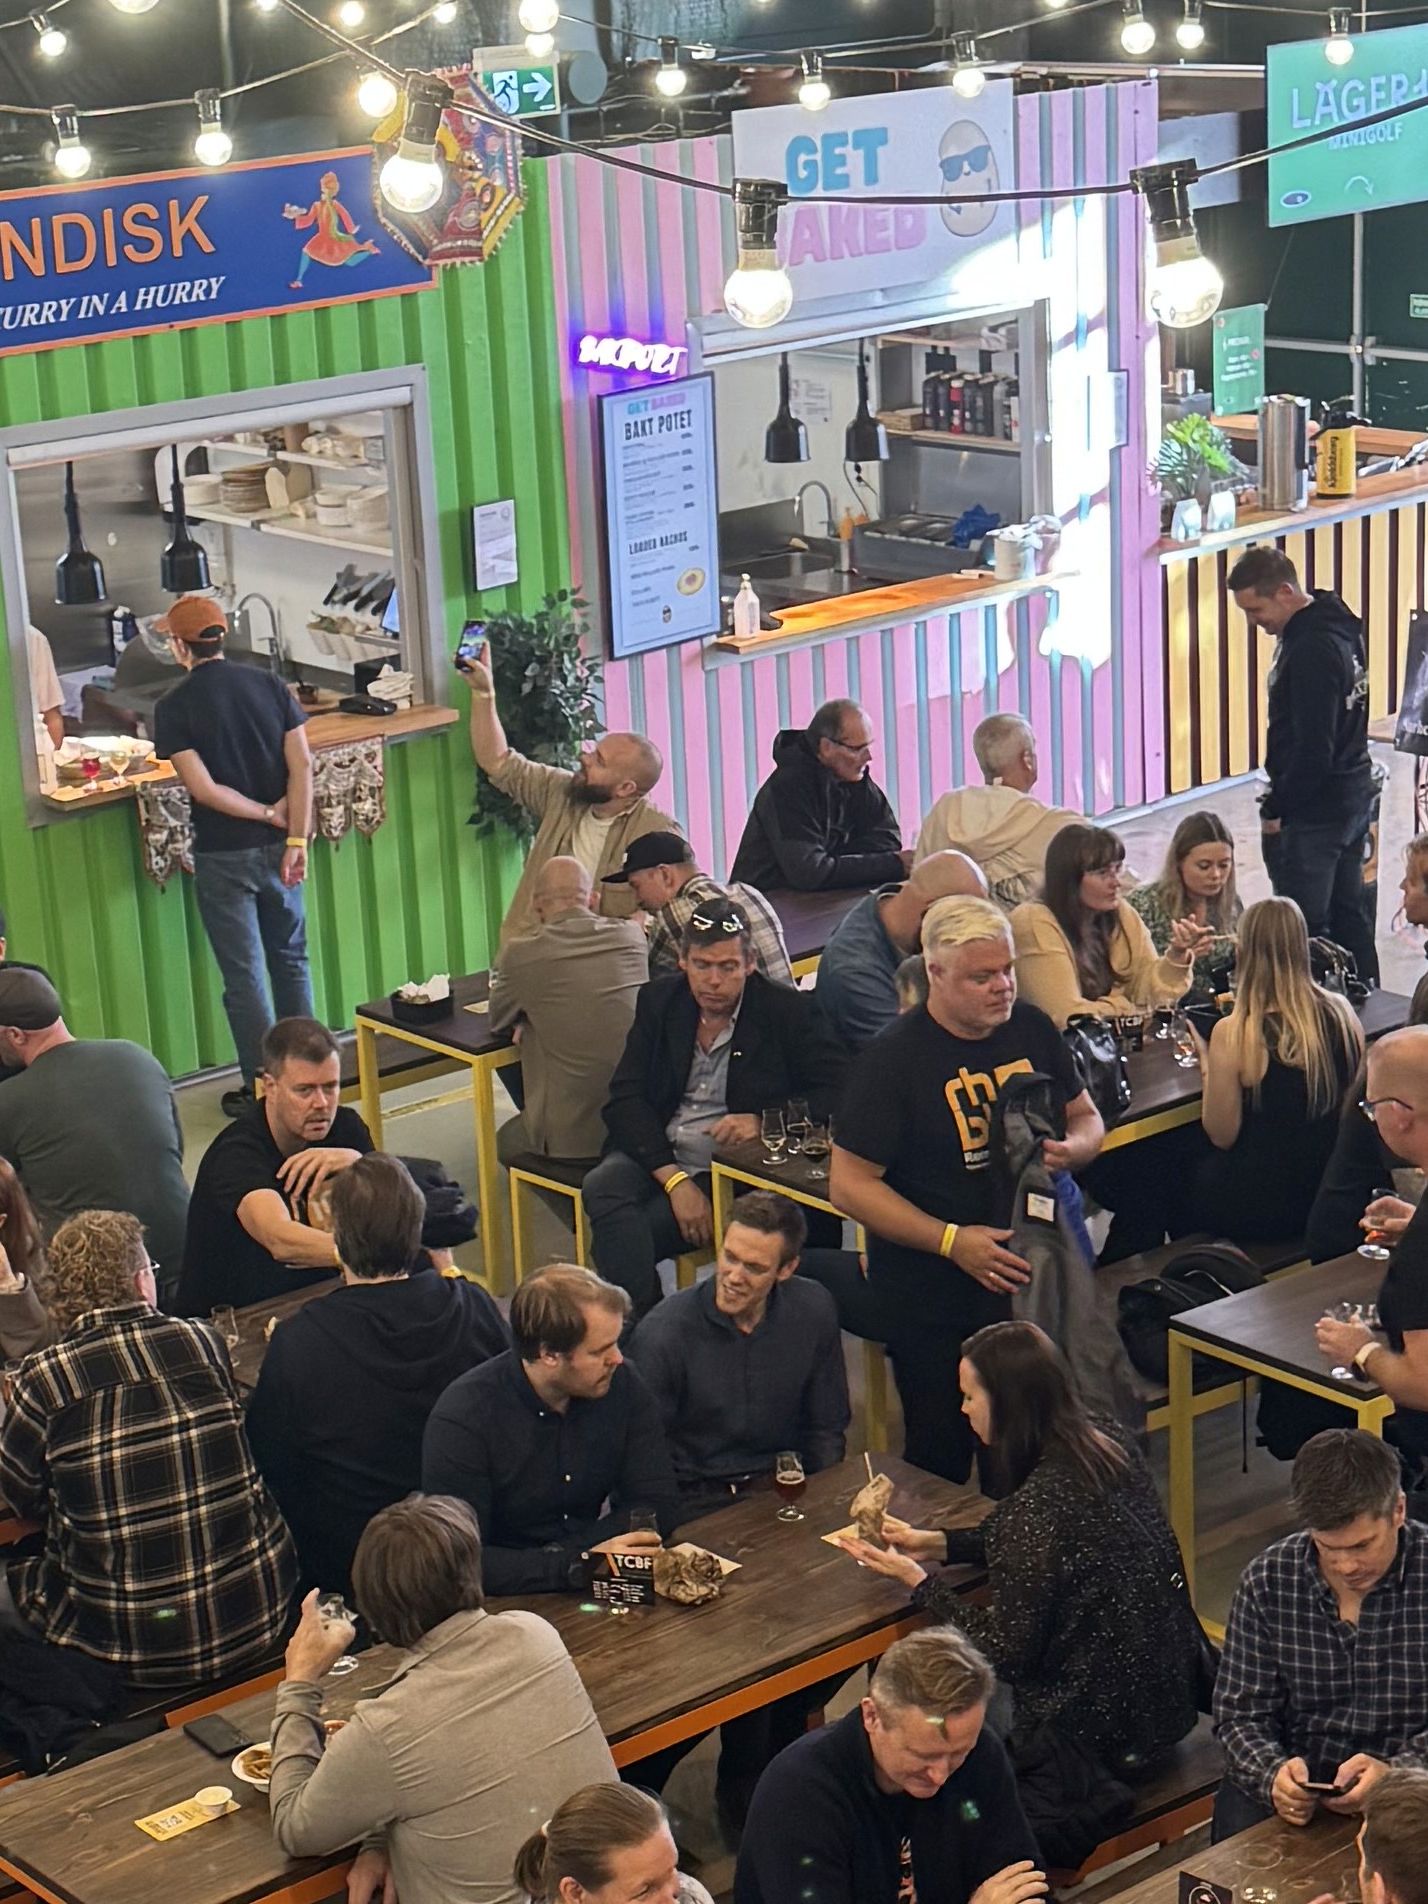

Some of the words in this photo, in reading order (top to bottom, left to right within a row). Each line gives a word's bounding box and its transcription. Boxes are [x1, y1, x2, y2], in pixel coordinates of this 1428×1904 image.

[785, 126, 888, 196] GET
[78, 292, 109, 319] IN
[110, 290, 129, 314] A
[134, 276, 226, 311] HURRY
[624, 417, 654, 441] BAKT
[658, 409, 692, 434] POTET
[614, 1554, 652, 1570] TCBF
